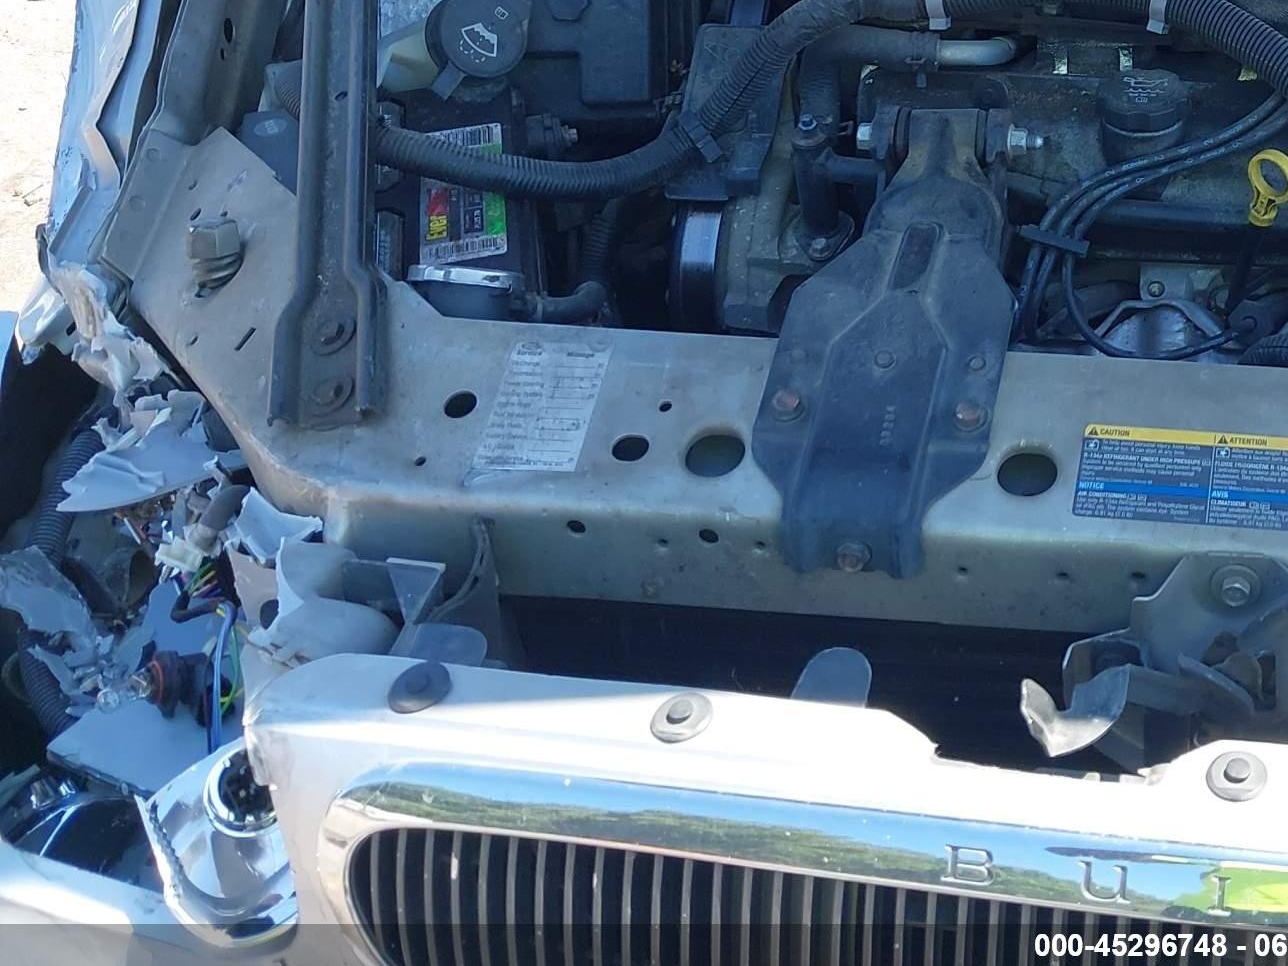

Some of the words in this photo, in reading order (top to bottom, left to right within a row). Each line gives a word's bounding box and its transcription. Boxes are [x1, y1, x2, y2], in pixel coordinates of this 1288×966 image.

[1099, 428, 1130, 436] CAUTION
[1229, 437, 1267, 446] ATTENTION
[1078, 481, 1104, 489] NOTICE
